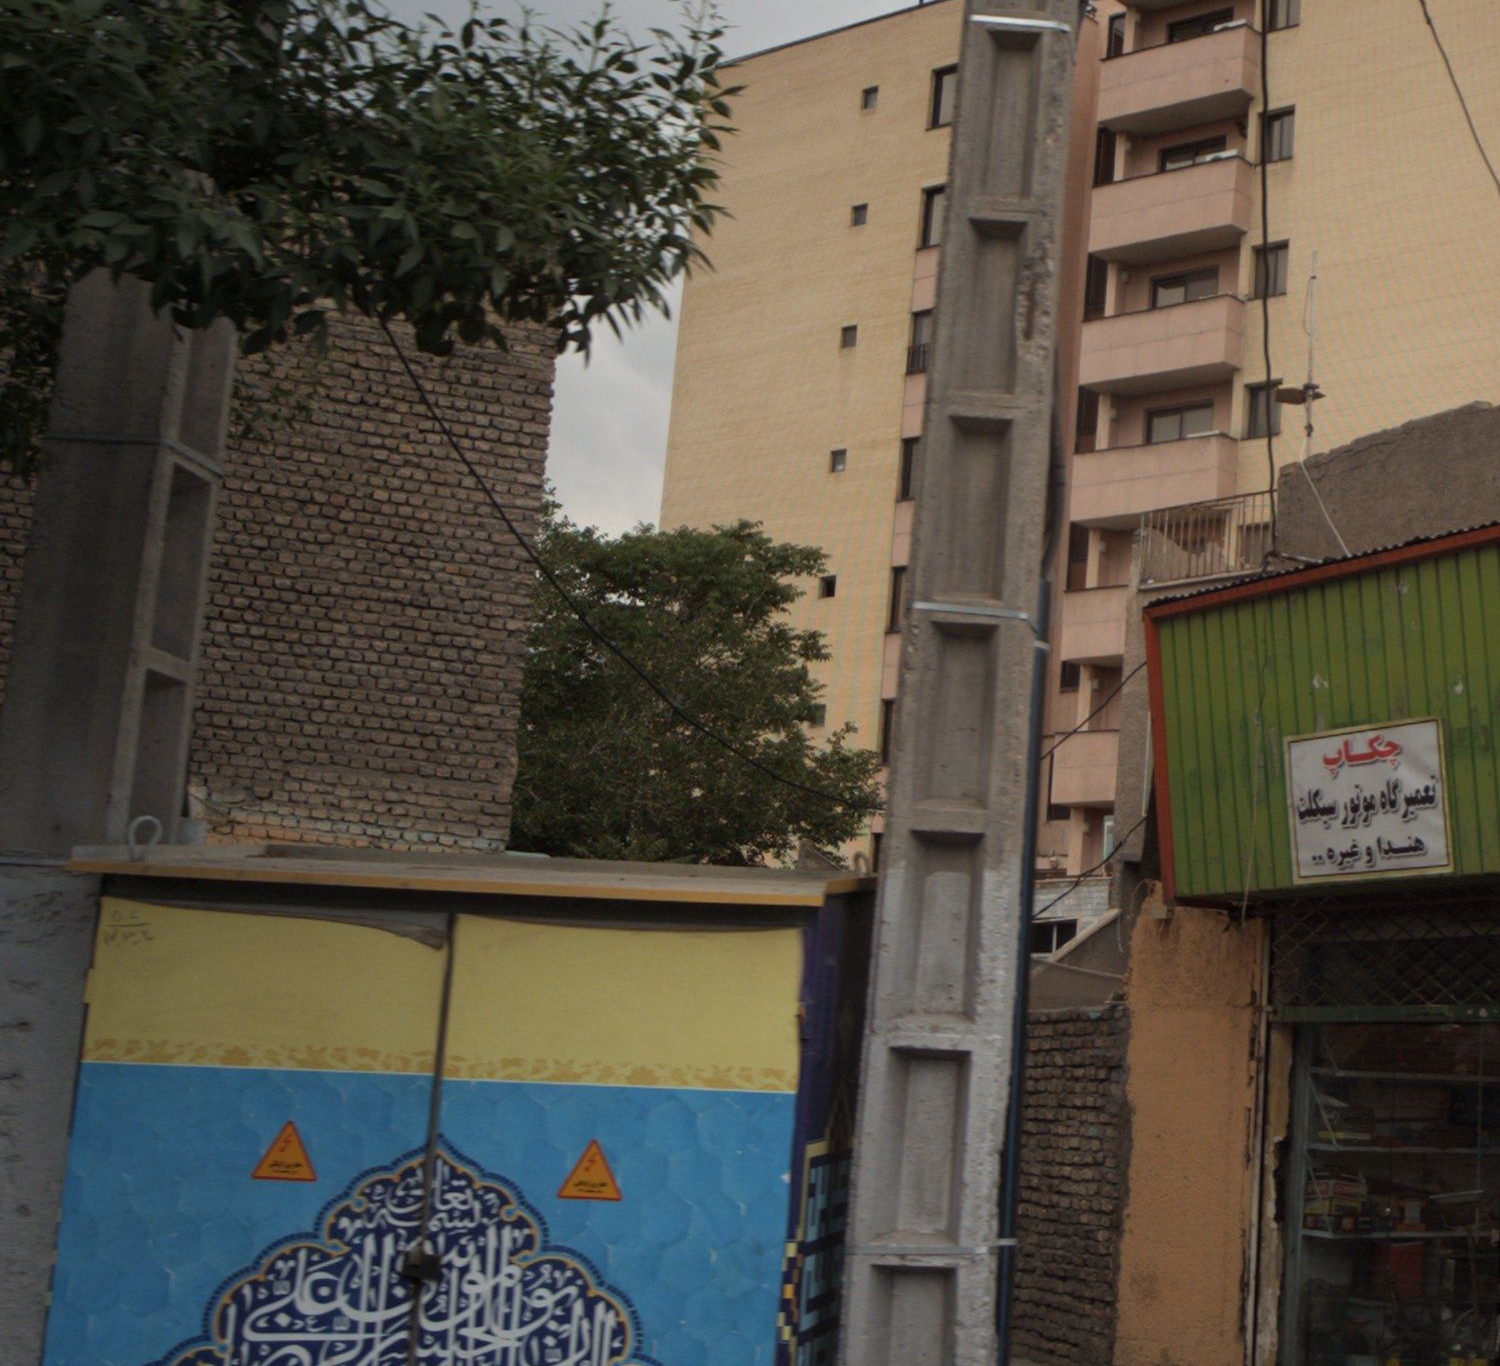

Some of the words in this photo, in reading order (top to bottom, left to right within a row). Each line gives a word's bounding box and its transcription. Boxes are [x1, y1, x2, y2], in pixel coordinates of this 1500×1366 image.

[1323, 734, 1401, 777] چکاپ
[1342, 785, 1376, 825] موتور
[1366, 845, 1373, 864] و
[1377, 836, 1425, 856] هندا
